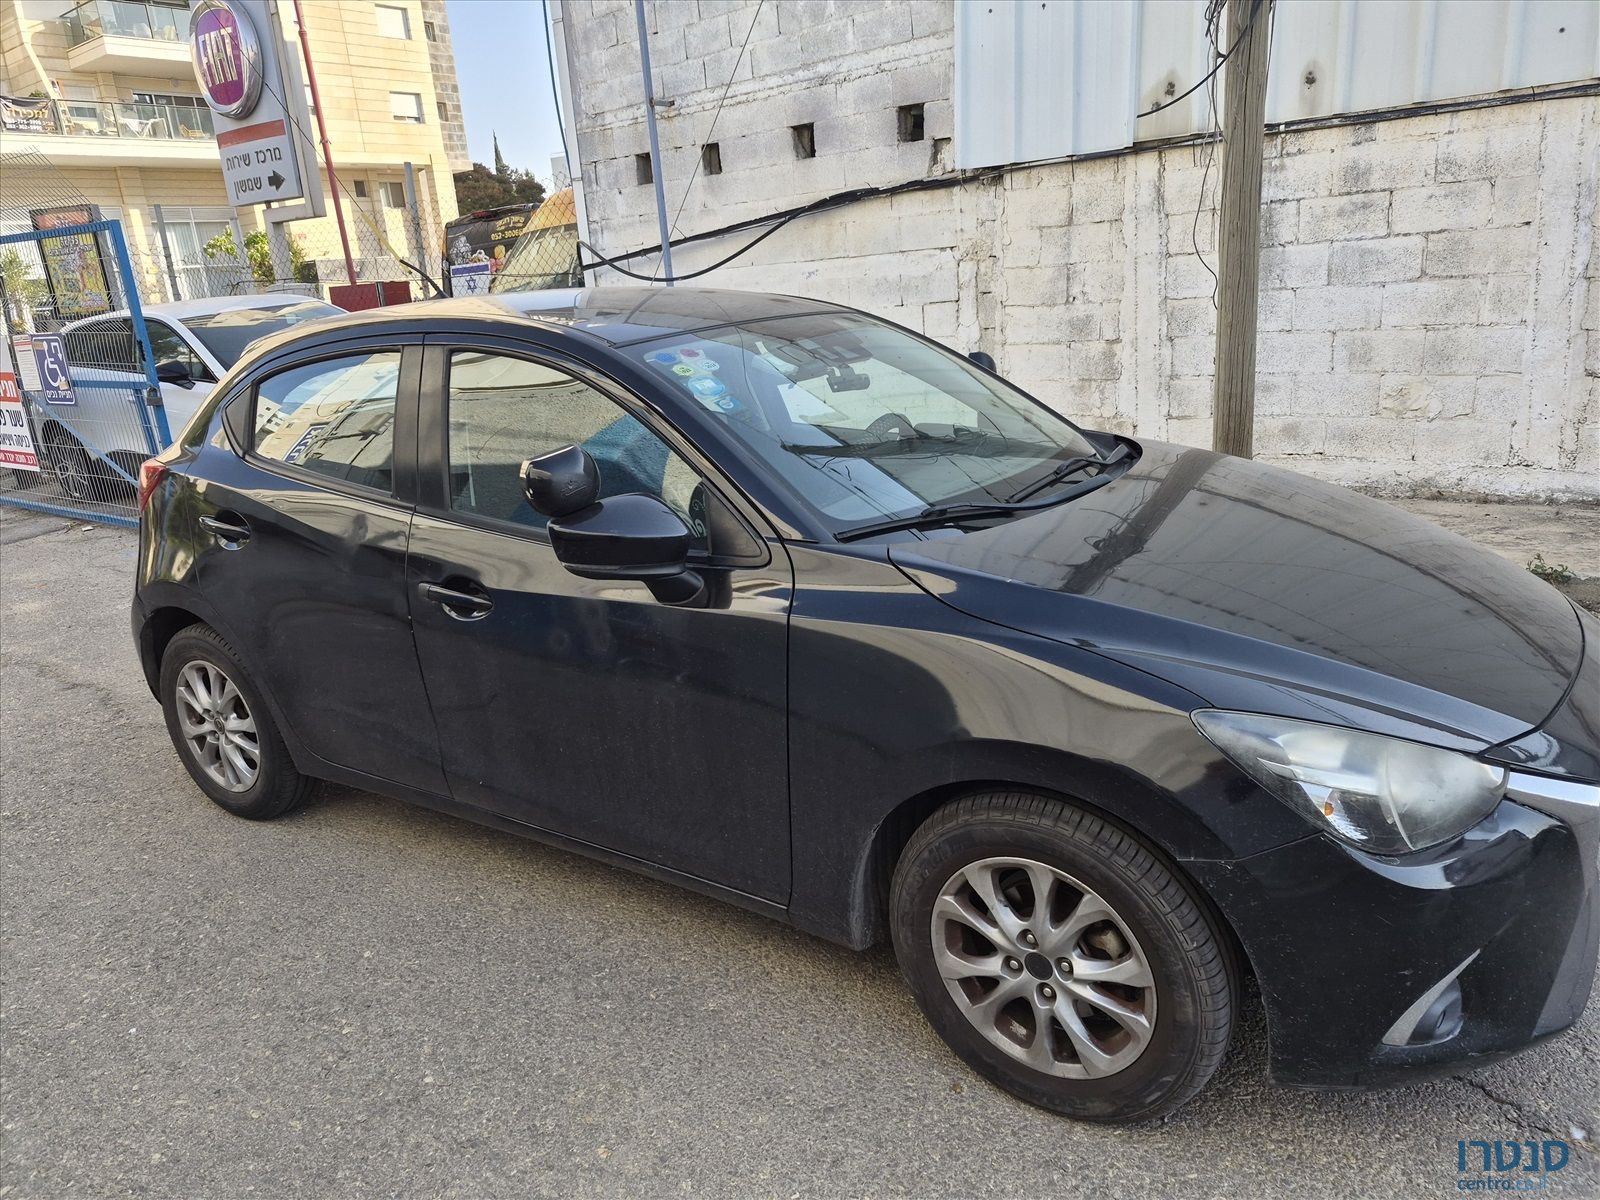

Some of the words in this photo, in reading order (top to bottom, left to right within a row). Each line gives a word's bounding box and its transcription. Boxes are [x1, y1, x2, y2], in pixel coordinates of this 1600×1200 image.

[198, 27, 238, 87] FIAT
[226, 153, 251, 171] שירות
[255, 147, 282, 164] מרכז
[234, 176, 262, 200] שמשון
[6, 409, 24, 427] שער
